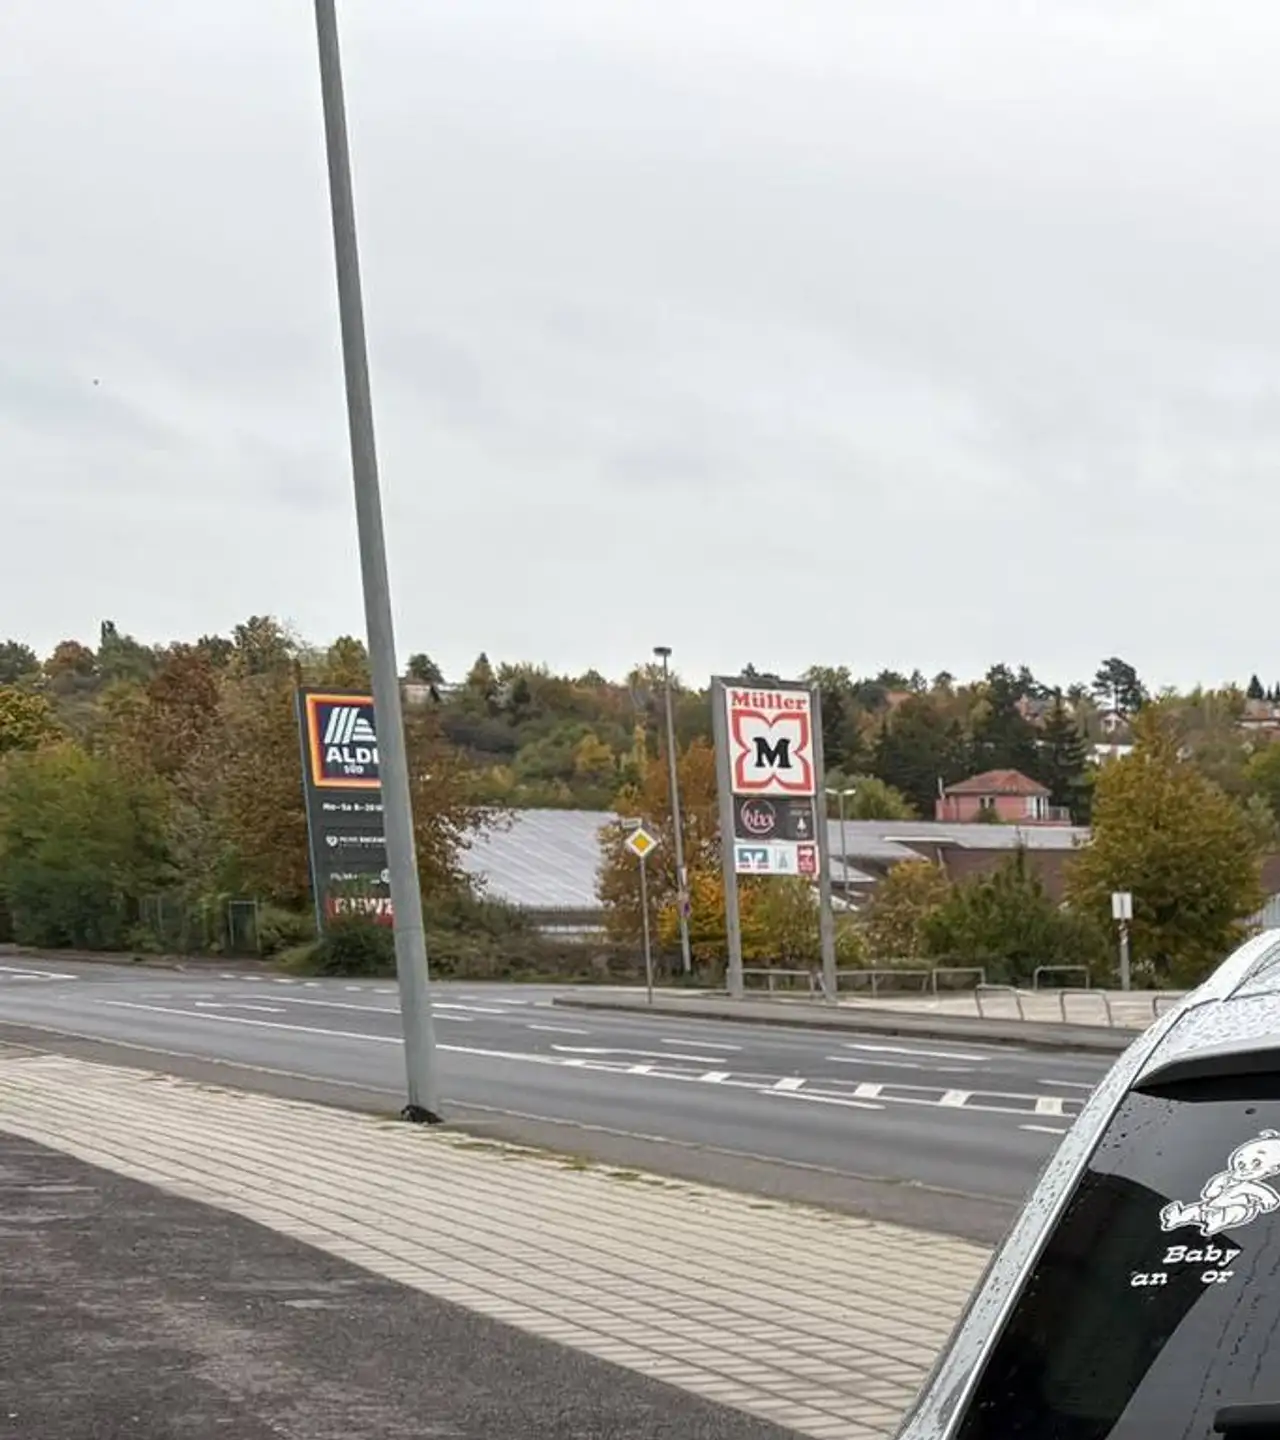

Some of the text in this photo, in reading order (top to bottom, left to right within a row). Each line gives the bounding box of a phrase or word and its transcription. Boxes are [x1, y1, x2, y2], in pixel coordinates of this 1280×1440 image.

[731, 690, 807, 709] Müller
[326, 746, 380, 765] ALDI
[752, 737, 793, 769] M
[1162, 1244, 1241, 1266] Baby
[1130, 1271, 1168, 1287] an
